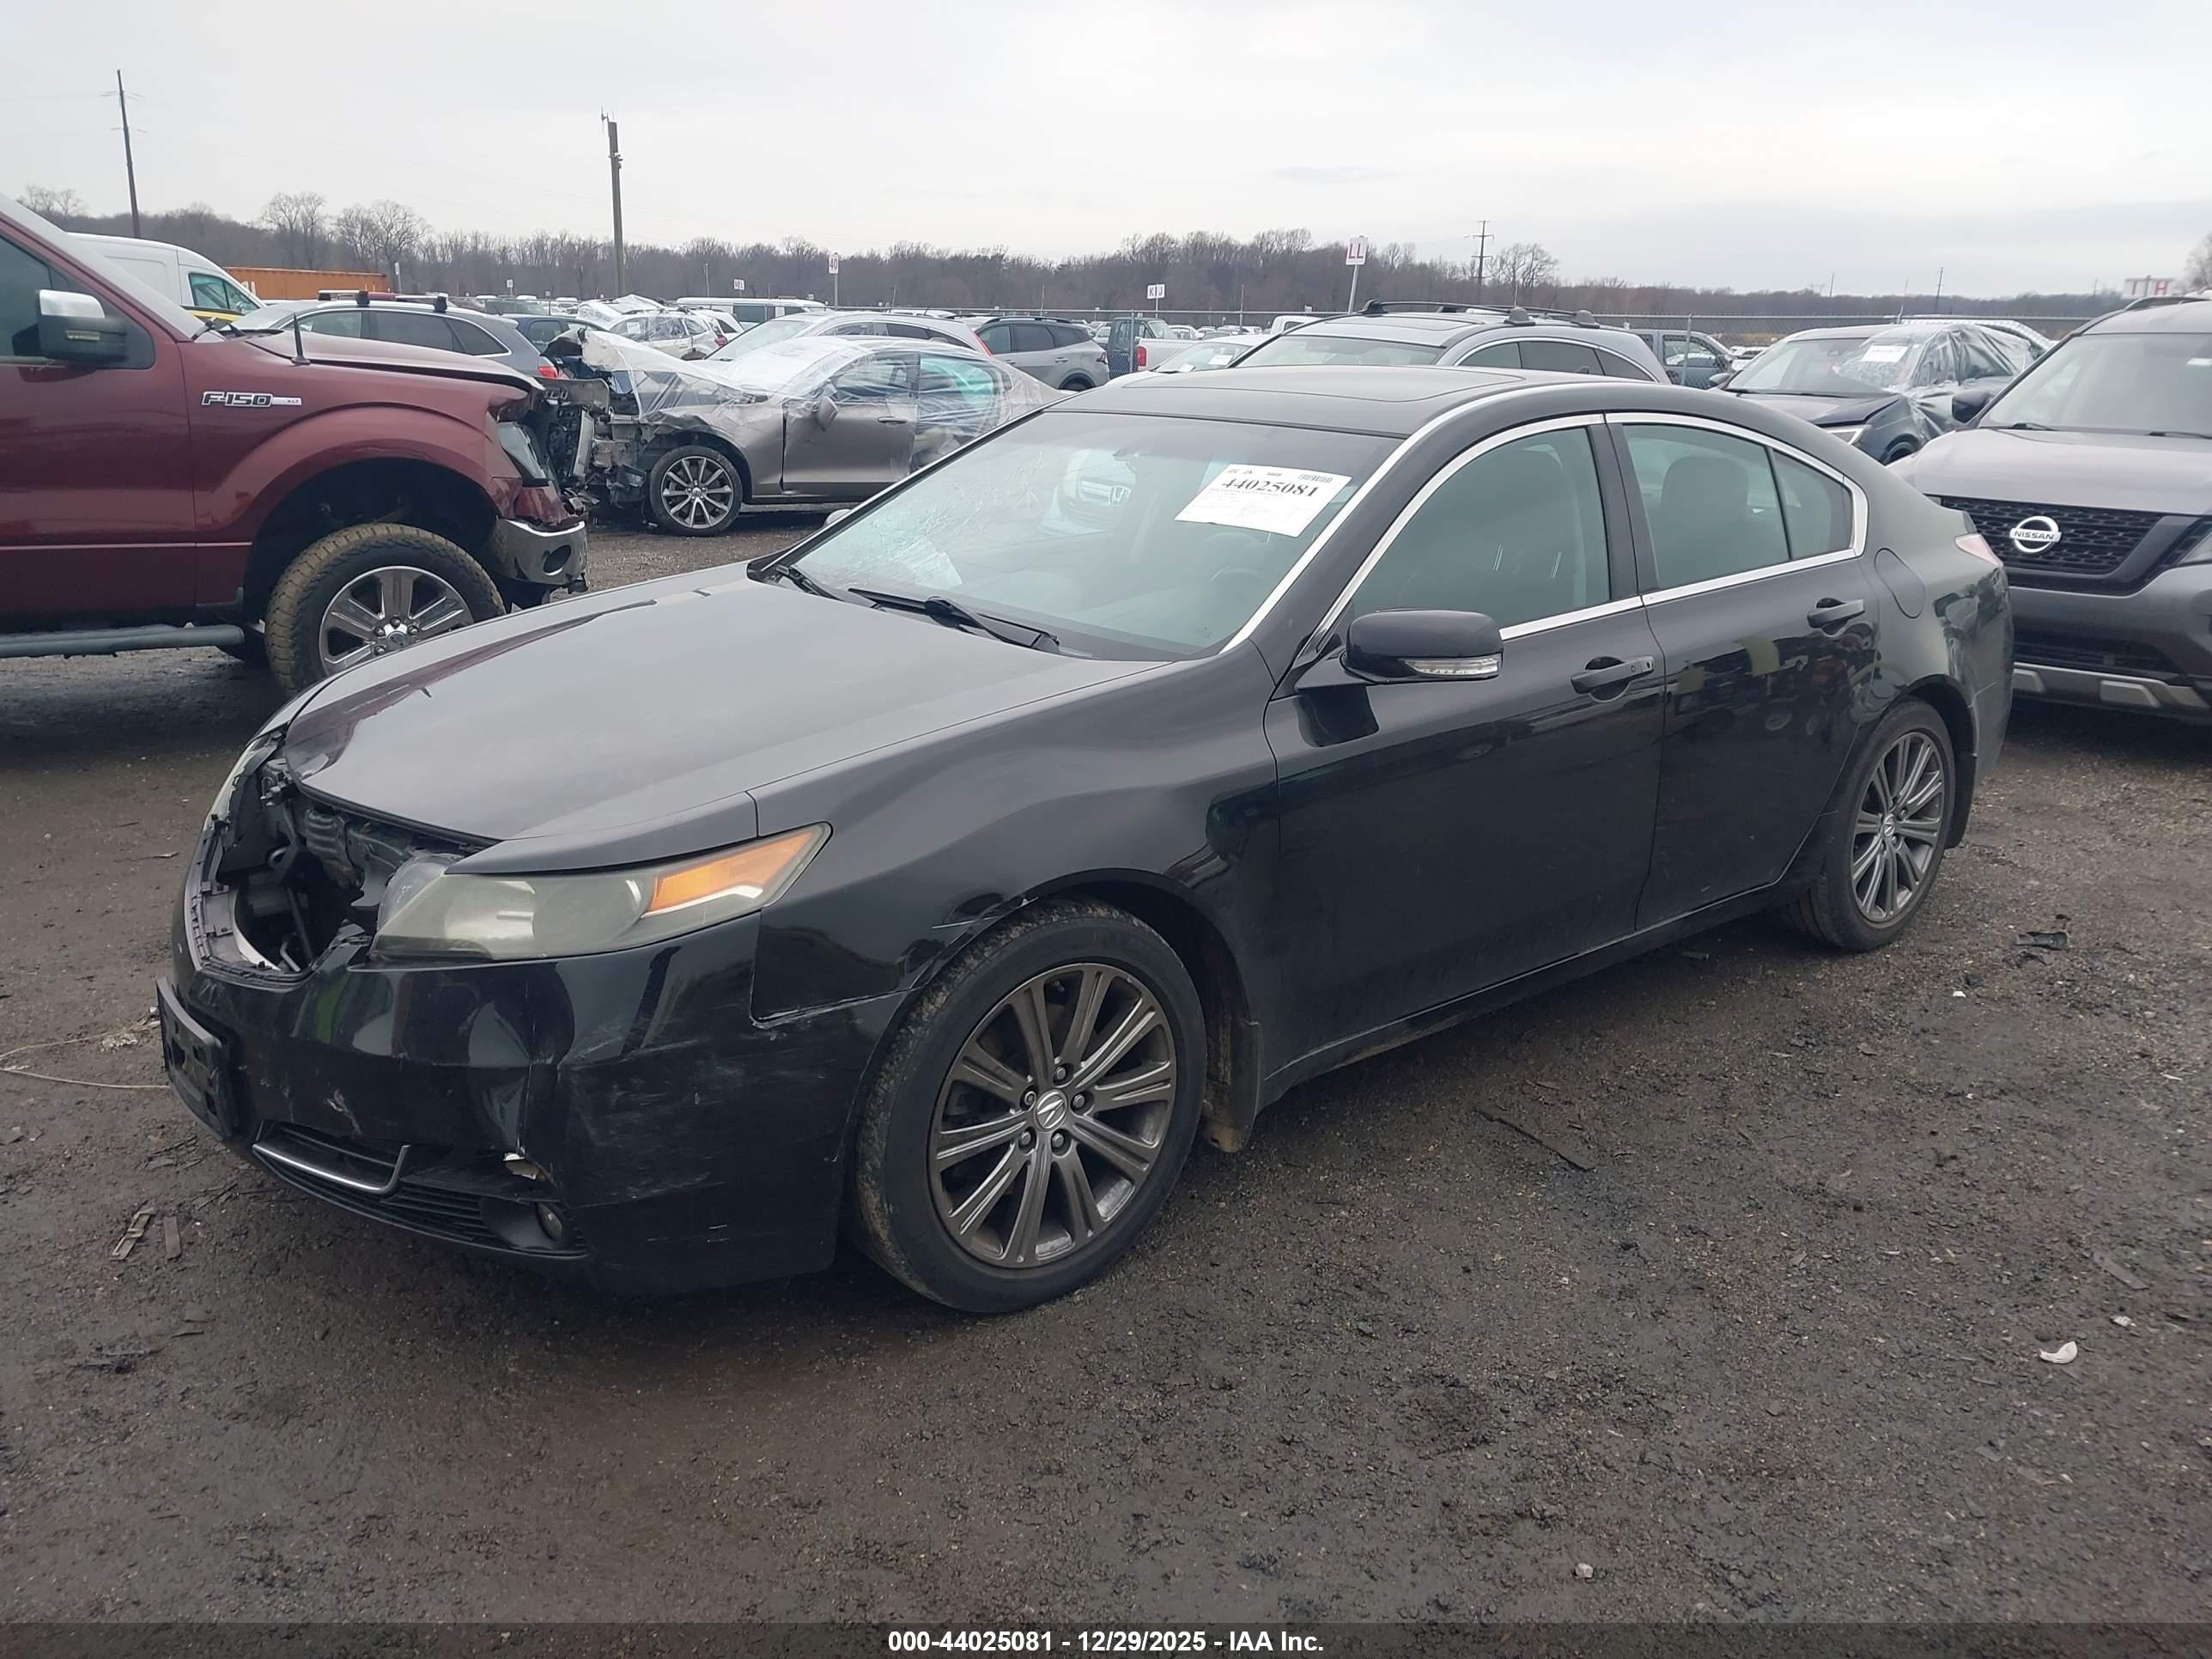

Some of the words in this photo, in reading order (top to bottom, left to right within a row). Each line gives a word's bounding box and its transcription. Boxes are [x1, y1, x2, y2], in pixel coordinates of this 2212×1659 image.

[1348, 243, 1364, 259] LL
[830, 258, 838, 270] 40
[201, 391, 274, 408] F-150
[1221, 477, 1319, 497] 44025081
[2014, 530, 2055, 540] NISSAN
